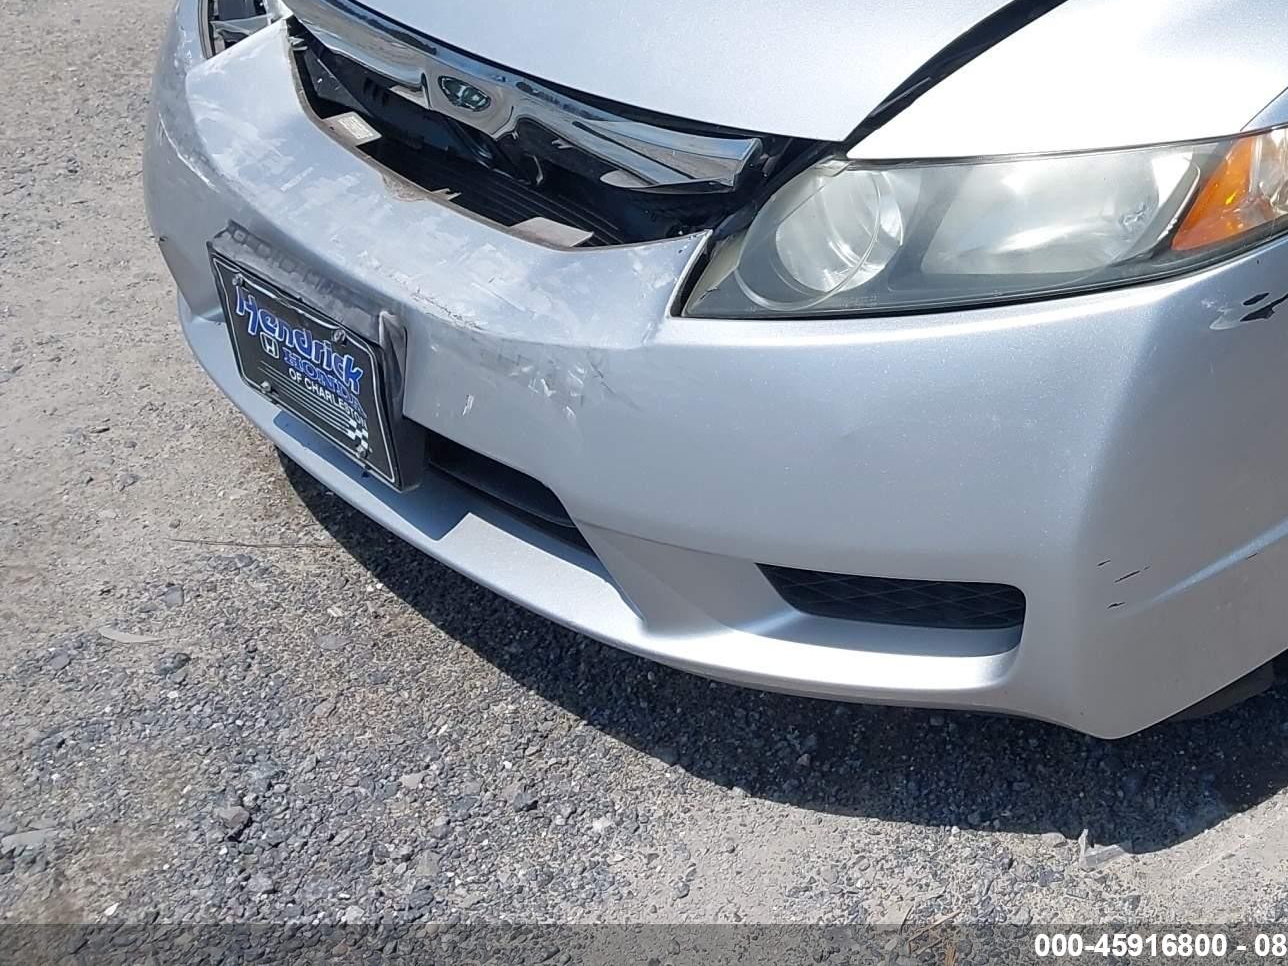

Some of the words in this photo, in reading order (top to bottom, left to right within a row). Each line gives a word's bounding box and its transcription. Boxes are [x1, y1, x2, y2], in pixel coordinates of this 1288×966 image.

[236, 286, 364, 395] Hendrick
[282, 347, 368, 418] HONDA
[288, 367, 303, 383] OF
[304, 375, 368, 431] CHARLESTON
